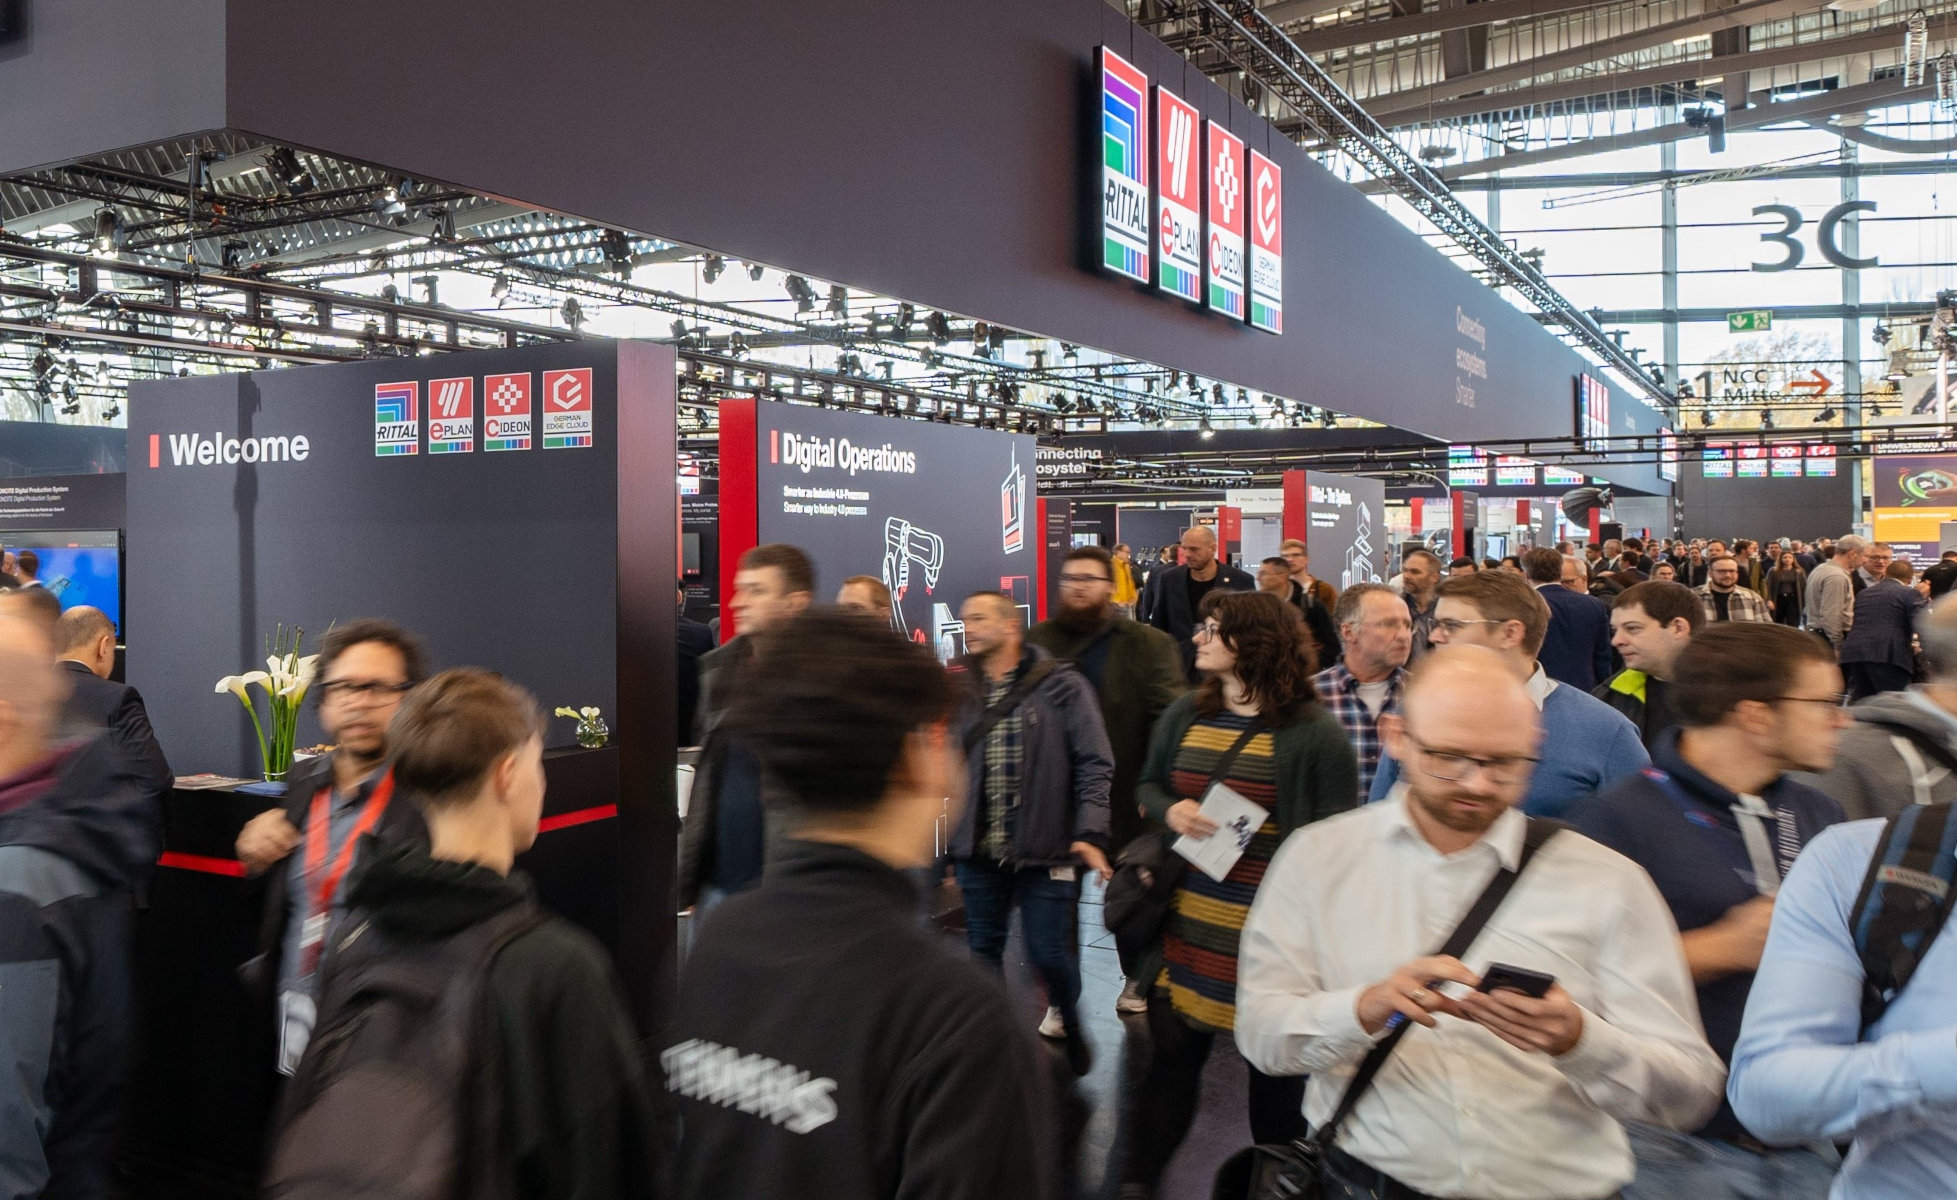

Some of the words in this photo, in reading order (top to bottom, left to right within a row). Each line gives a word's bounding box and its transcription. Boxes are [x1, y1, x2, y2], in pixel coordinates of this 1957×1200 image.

[1105, 177, 1148, 234] RITTAL
[1210, 232, 1244, 277] CIDEON
[1750, 200, 1879, 273] 3C
[1723, 369, 1768, 384] NCC
[377, 424, 417, 440] RITTAL
[485, 419, 530, 438] CIDEON
[169, 432, 310, 466] Welcome
[783, 432, 835, 474] Digital
[838, 437, 916, 476] Operations
